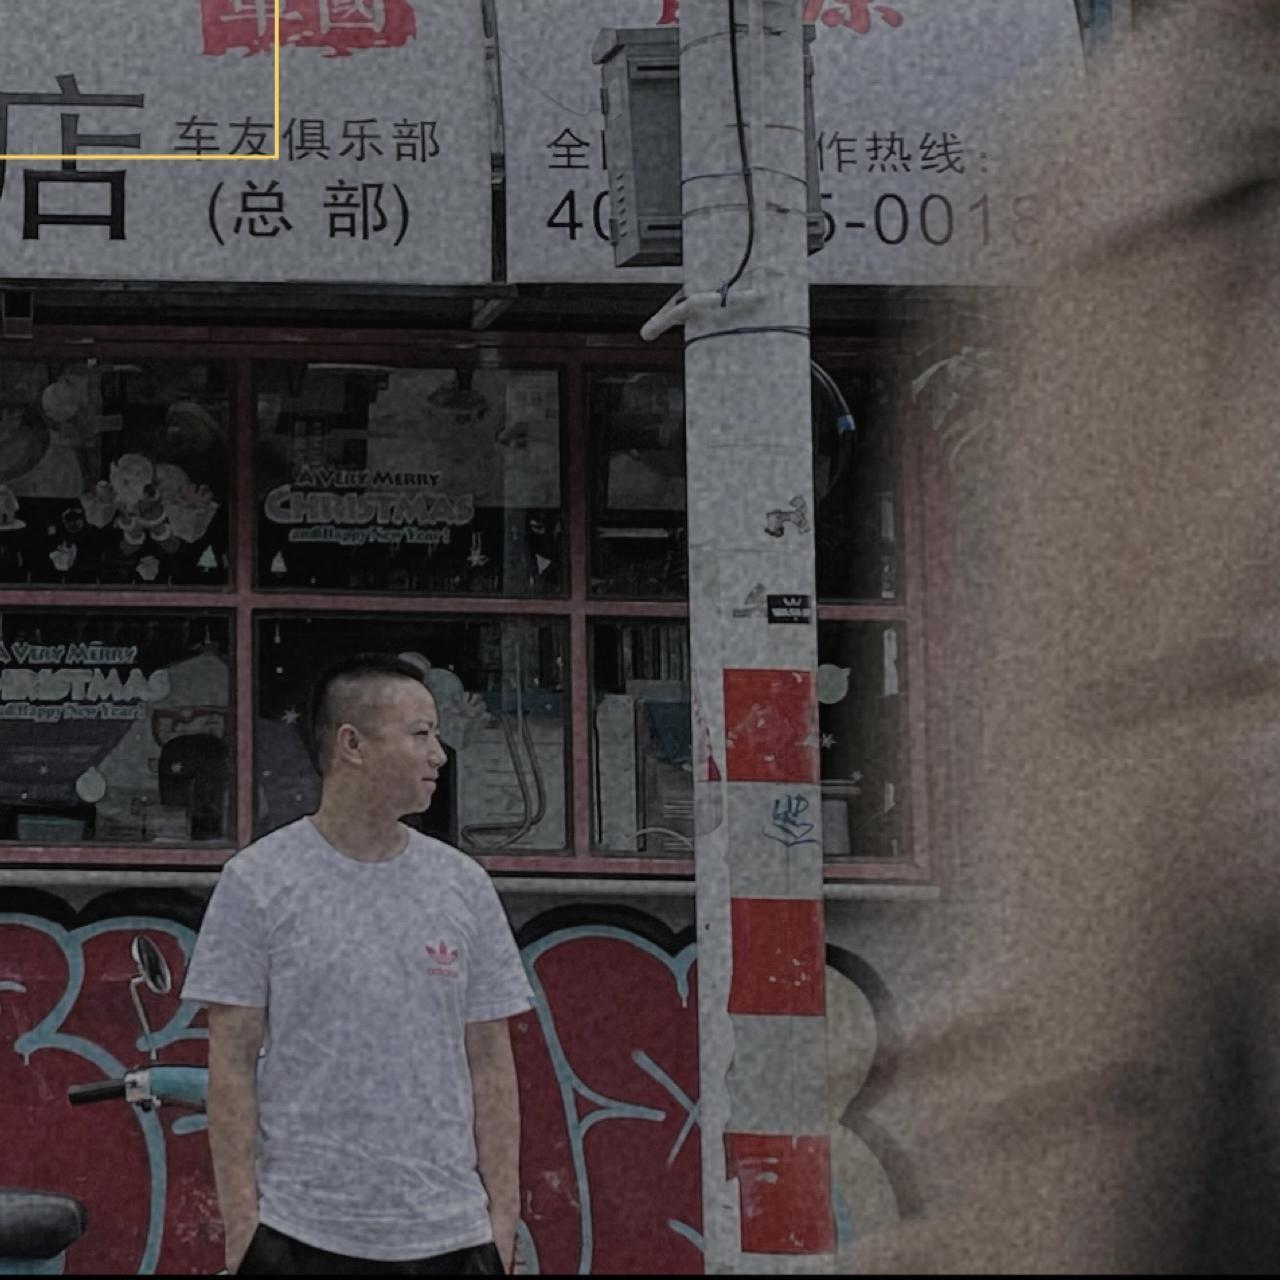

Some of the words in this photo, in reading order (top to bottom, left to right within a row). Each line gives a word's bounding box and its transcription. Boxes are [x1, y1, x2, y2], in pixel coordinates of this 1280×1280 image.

[173, 114, 441, 163] 车友俱乐部
[294, 464, 316, 486] A
